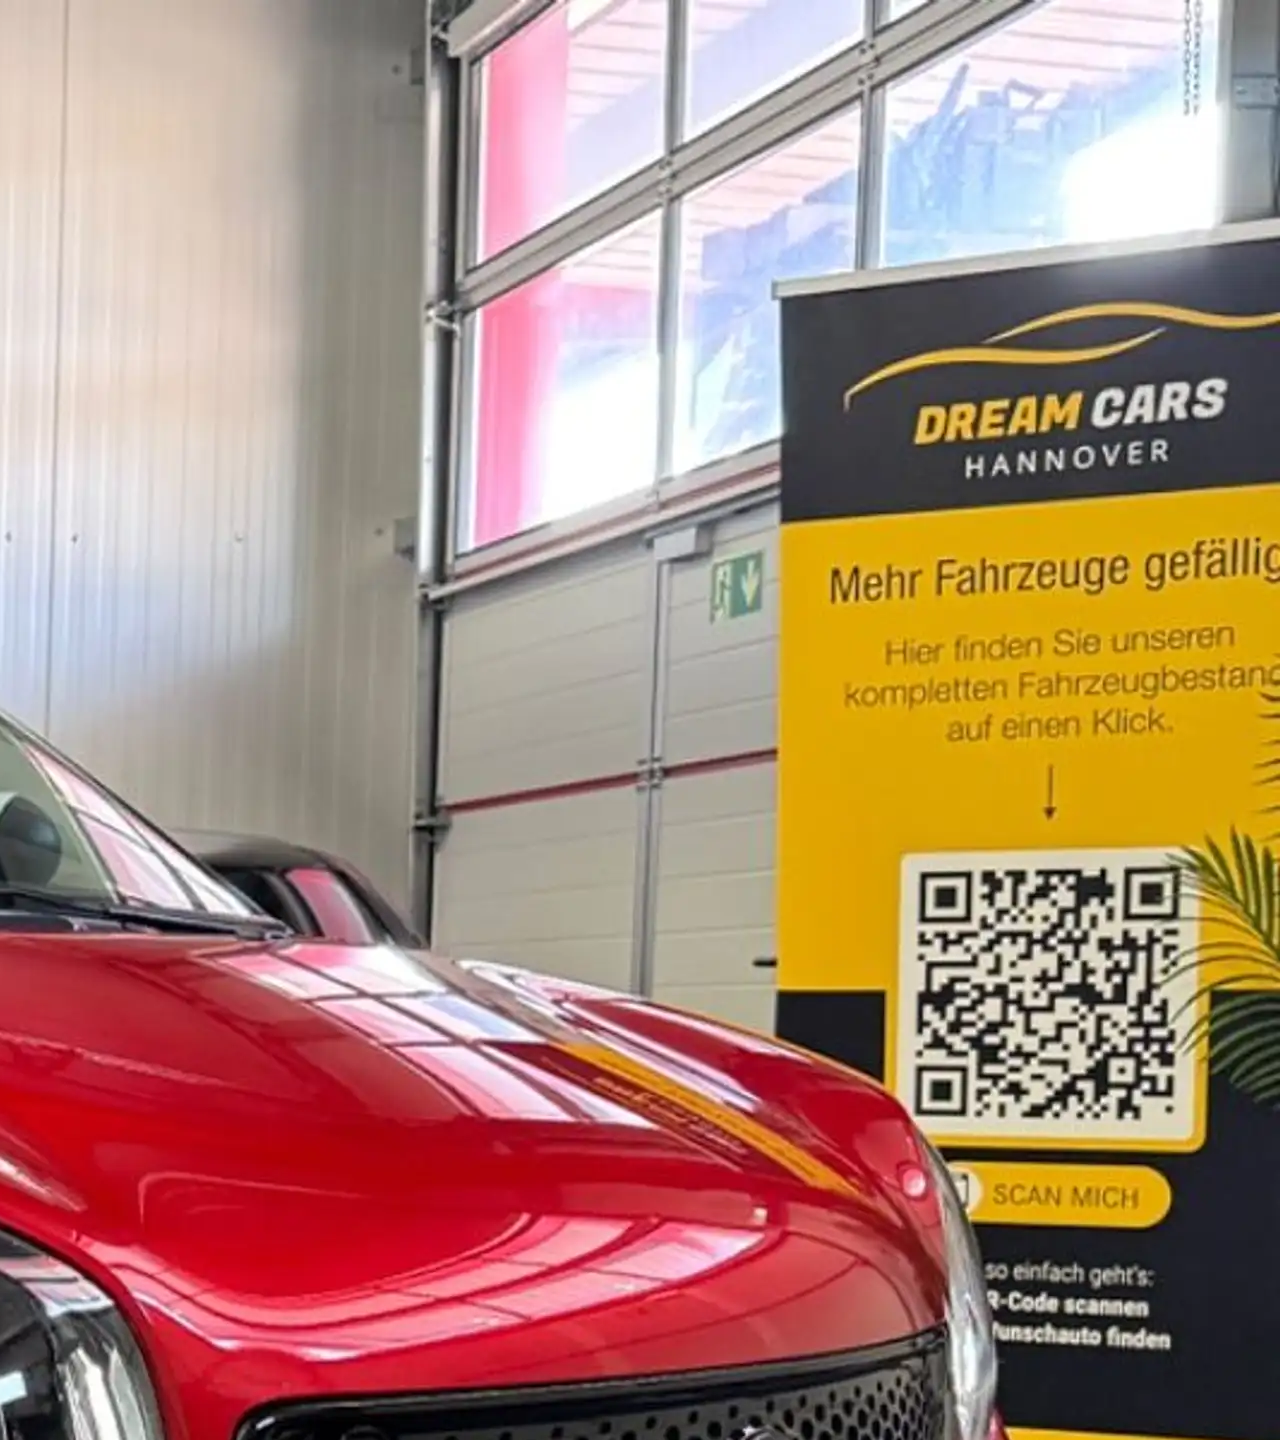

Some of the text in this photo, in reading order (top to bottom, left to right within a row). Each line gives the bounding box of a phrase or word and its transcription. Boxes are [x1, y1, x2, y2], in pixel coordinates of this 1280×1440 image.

[914, 378, 1229, 445] DREAM CARS
[965, 440, 1170, 479] HANNOVER
[830, 565, 922, 604] Mehr
[936, 552, 1130, 595] Fahrzeuge
[885, 624, 1236, 666] Hier finden Sie unseren
[844, 676, 1008, 711] kompletten
[947, 705, 1173, 743] auf einen Klick.
[993, 1182, 1140, 1211] SCAN MICH
[1013, 1261, 1085, 1284] einfach
[986, 1290, 1150, 1318] R-Code scannen
[1106, 1325, 1172, 1350] finden
